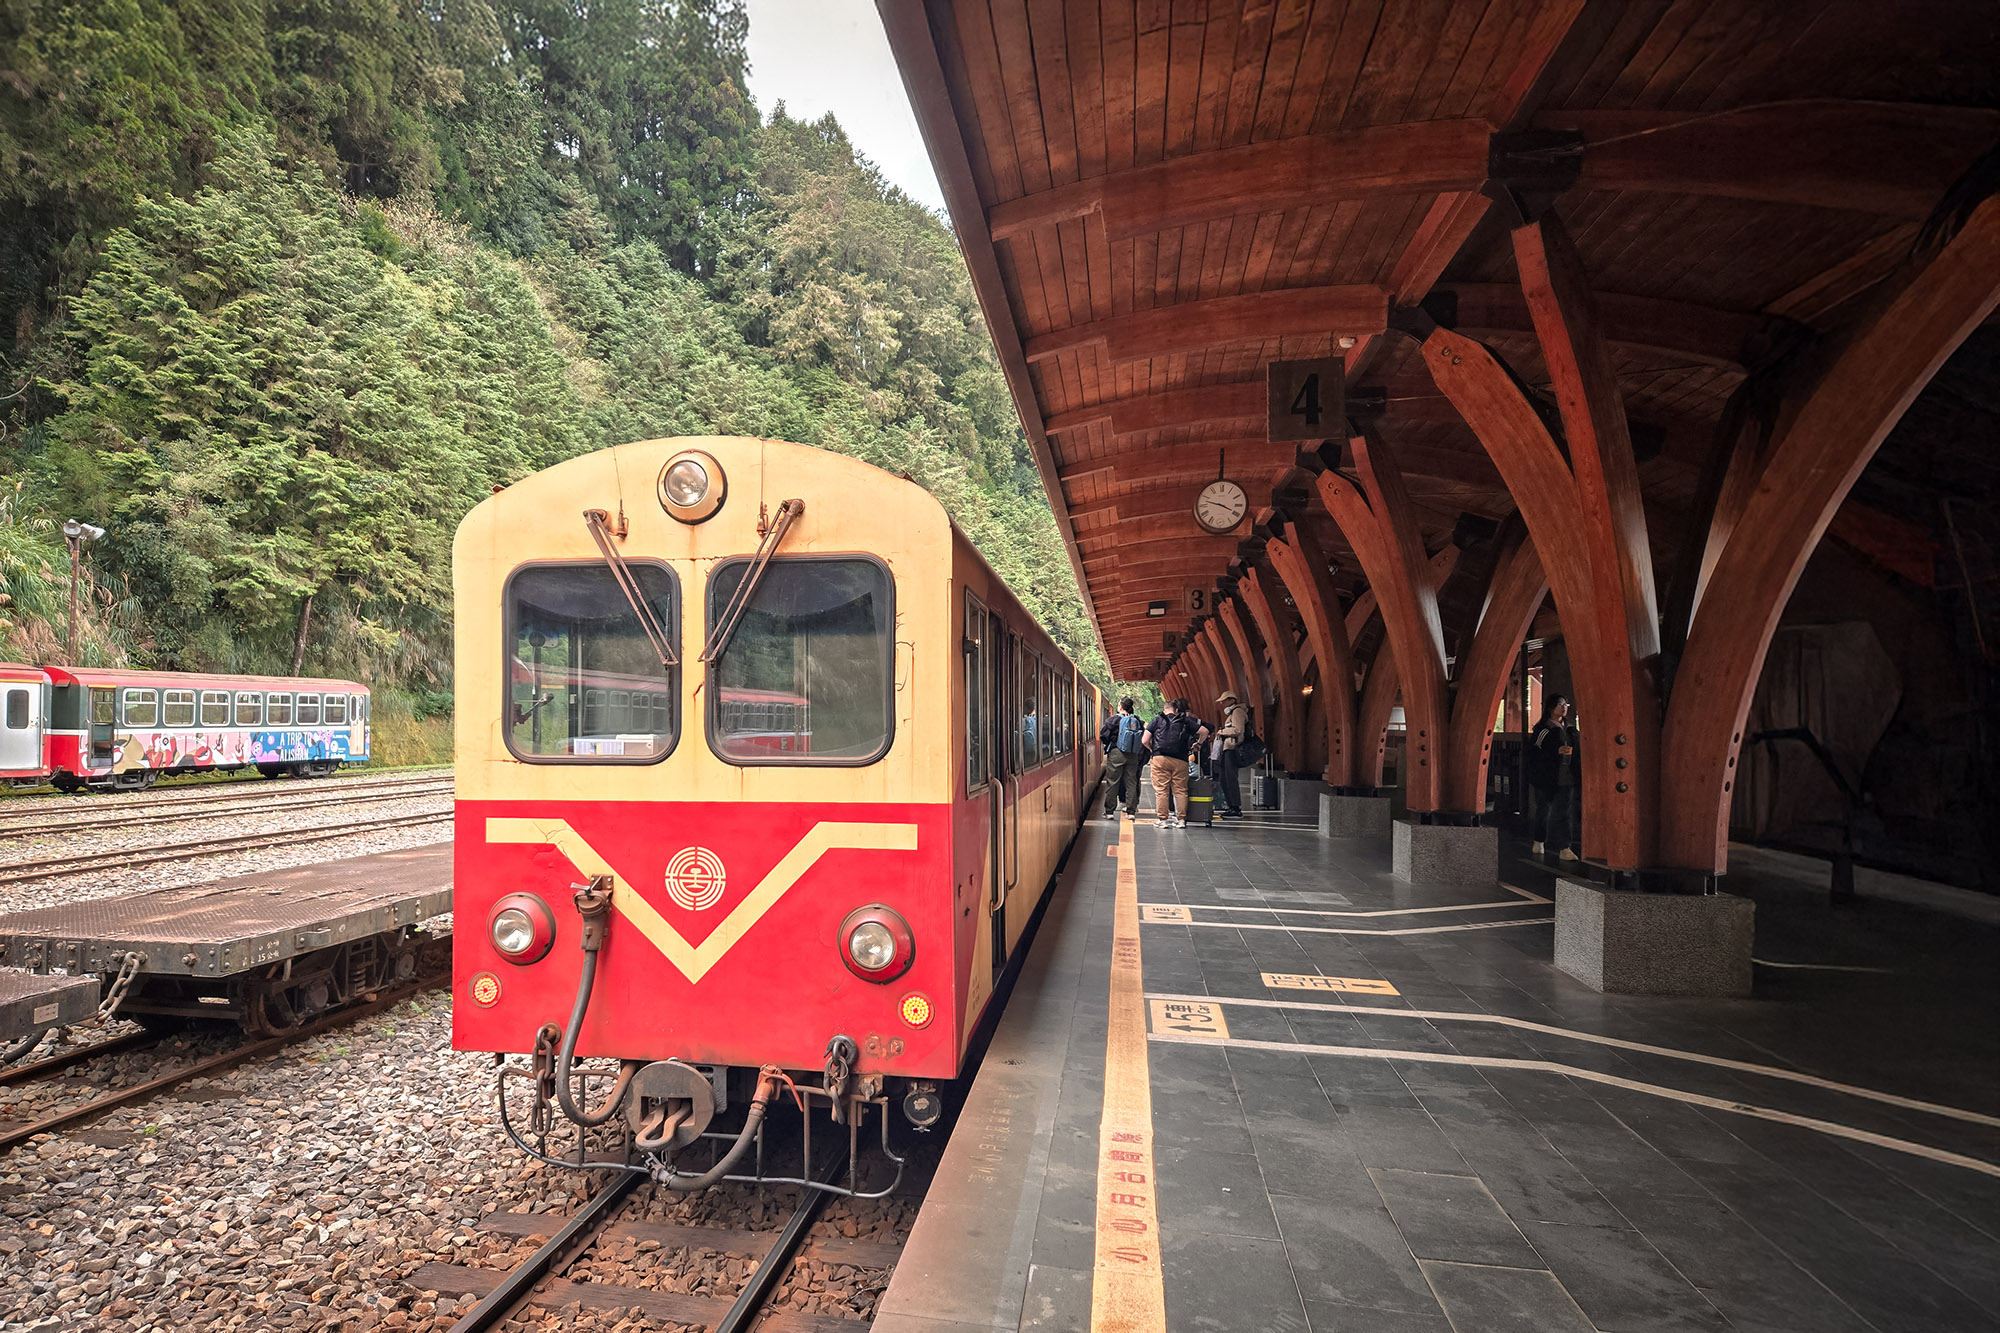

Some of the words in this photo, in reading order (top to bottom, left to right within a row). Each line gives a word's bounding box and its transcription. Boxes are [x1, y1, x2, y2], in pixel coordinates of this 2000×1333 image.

[1291, 373, 1323, 424] 4
[1191, 590, 1204, 610] 3
[1168, 635, 1176, 648] 2
[1156, 661, 1161, 670] 1
[280, 732, 285, 746] A
[303, 732, 312, 748] TO
[1165, 1012, 1213, 1023] 5
